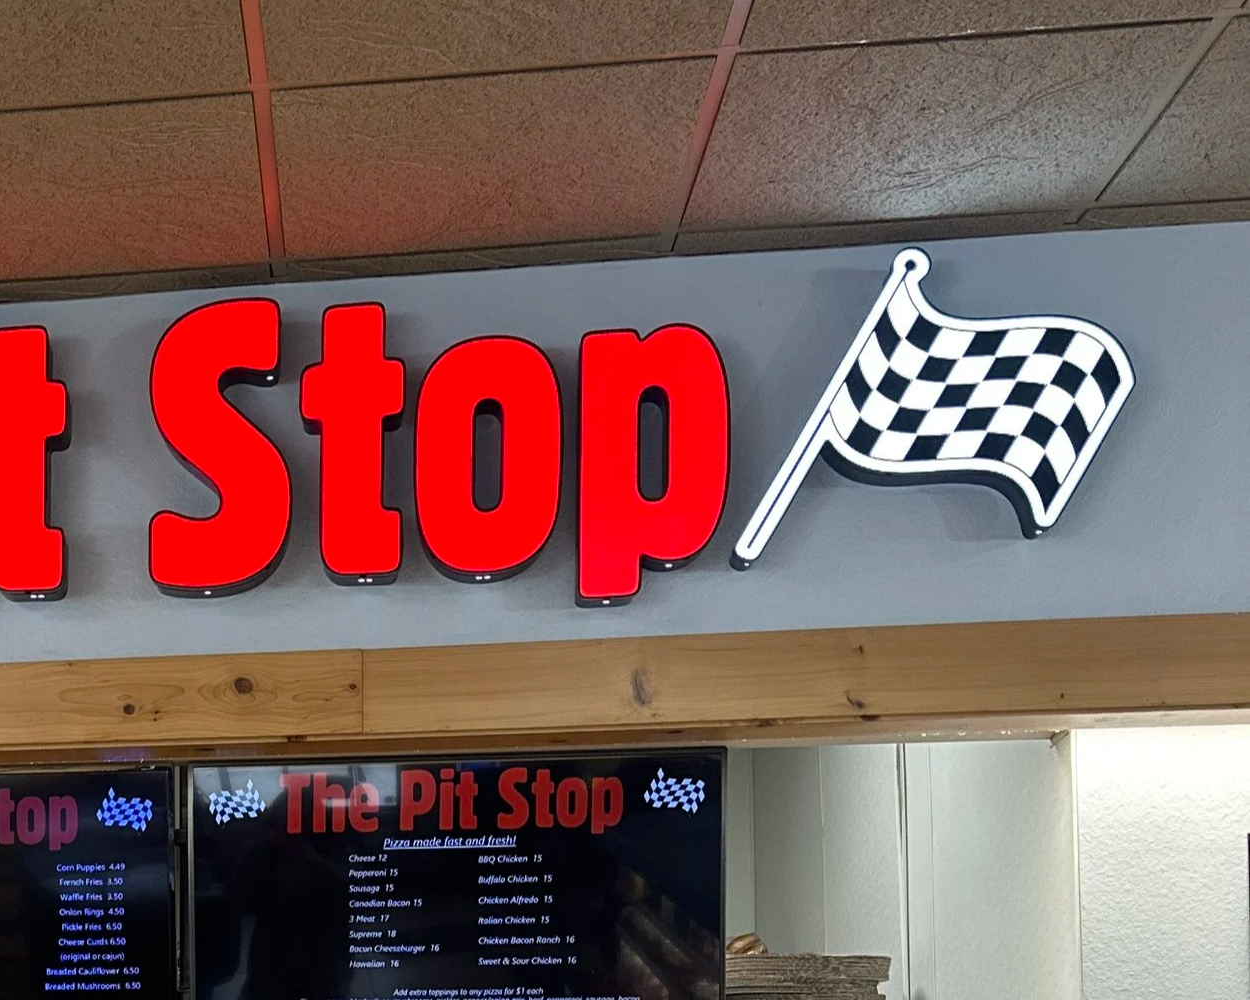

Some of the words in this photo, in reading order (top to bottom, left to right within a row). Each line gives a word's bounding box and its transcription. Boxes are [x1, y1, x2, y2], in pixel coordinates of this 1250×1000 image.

[148, 298, 731, 605] Stop
[280, 772, 379, 835] The
[399, 768, 479, 834] Pit
[496, 767, 624, 834] Stop
[383, 838, 410, 848] Pizza
[413, 837, 442, 848] made
[443, 836, 463, 847] fast
[463, 835, 486, 847] and
[486, 835, 516, 846] fresh!
[349, 854, 375, 862] Cheese
[478, 855, 495, 864] BBQ
[497, 855, 528, 863] Chicken
[56, 864, 74, 872] Corn
[76, 864, 105, 872] Puppies
[349, 869, 386, 879] Pepperoni
[59, 878, 84, 886] French
[478, 875, 505, 884] Buffalo
[507, 875, 538, 883] Chicken
[349, 885, 380, 894] Sausage
[349, 899, 385, 907] Canadian
[387, 899, 410, 907] Bacon
[478, 896, 509, 904] Chicken
[510, 895, 538, 905] Alfredo
[59, 908, 82, 916] Onion
[84, 908, 104, 917] Rings
[478, 916, 503, 924] Italian
[505, 916, 535, 924] Chicken
[62, 923, 83, 931] Pickle
[349, 930, 382, 940] Supreme
[58, 938, 84, 946] Cheese
[510, 936, 534, 944] Bacon
[536, 936, 560, 944] Ranch
[349, 945, 372, 953] Bacon
[374, 944, 425, 954] Cheeseburger
[478, 957, 501, 965] Sweet
[512, 957, 529, 965] Sour
[531, 956, 562, 964] Chicken
[45, 982, 75, 990] Breaded
[77, 982, 120, 990] Mushrooms
